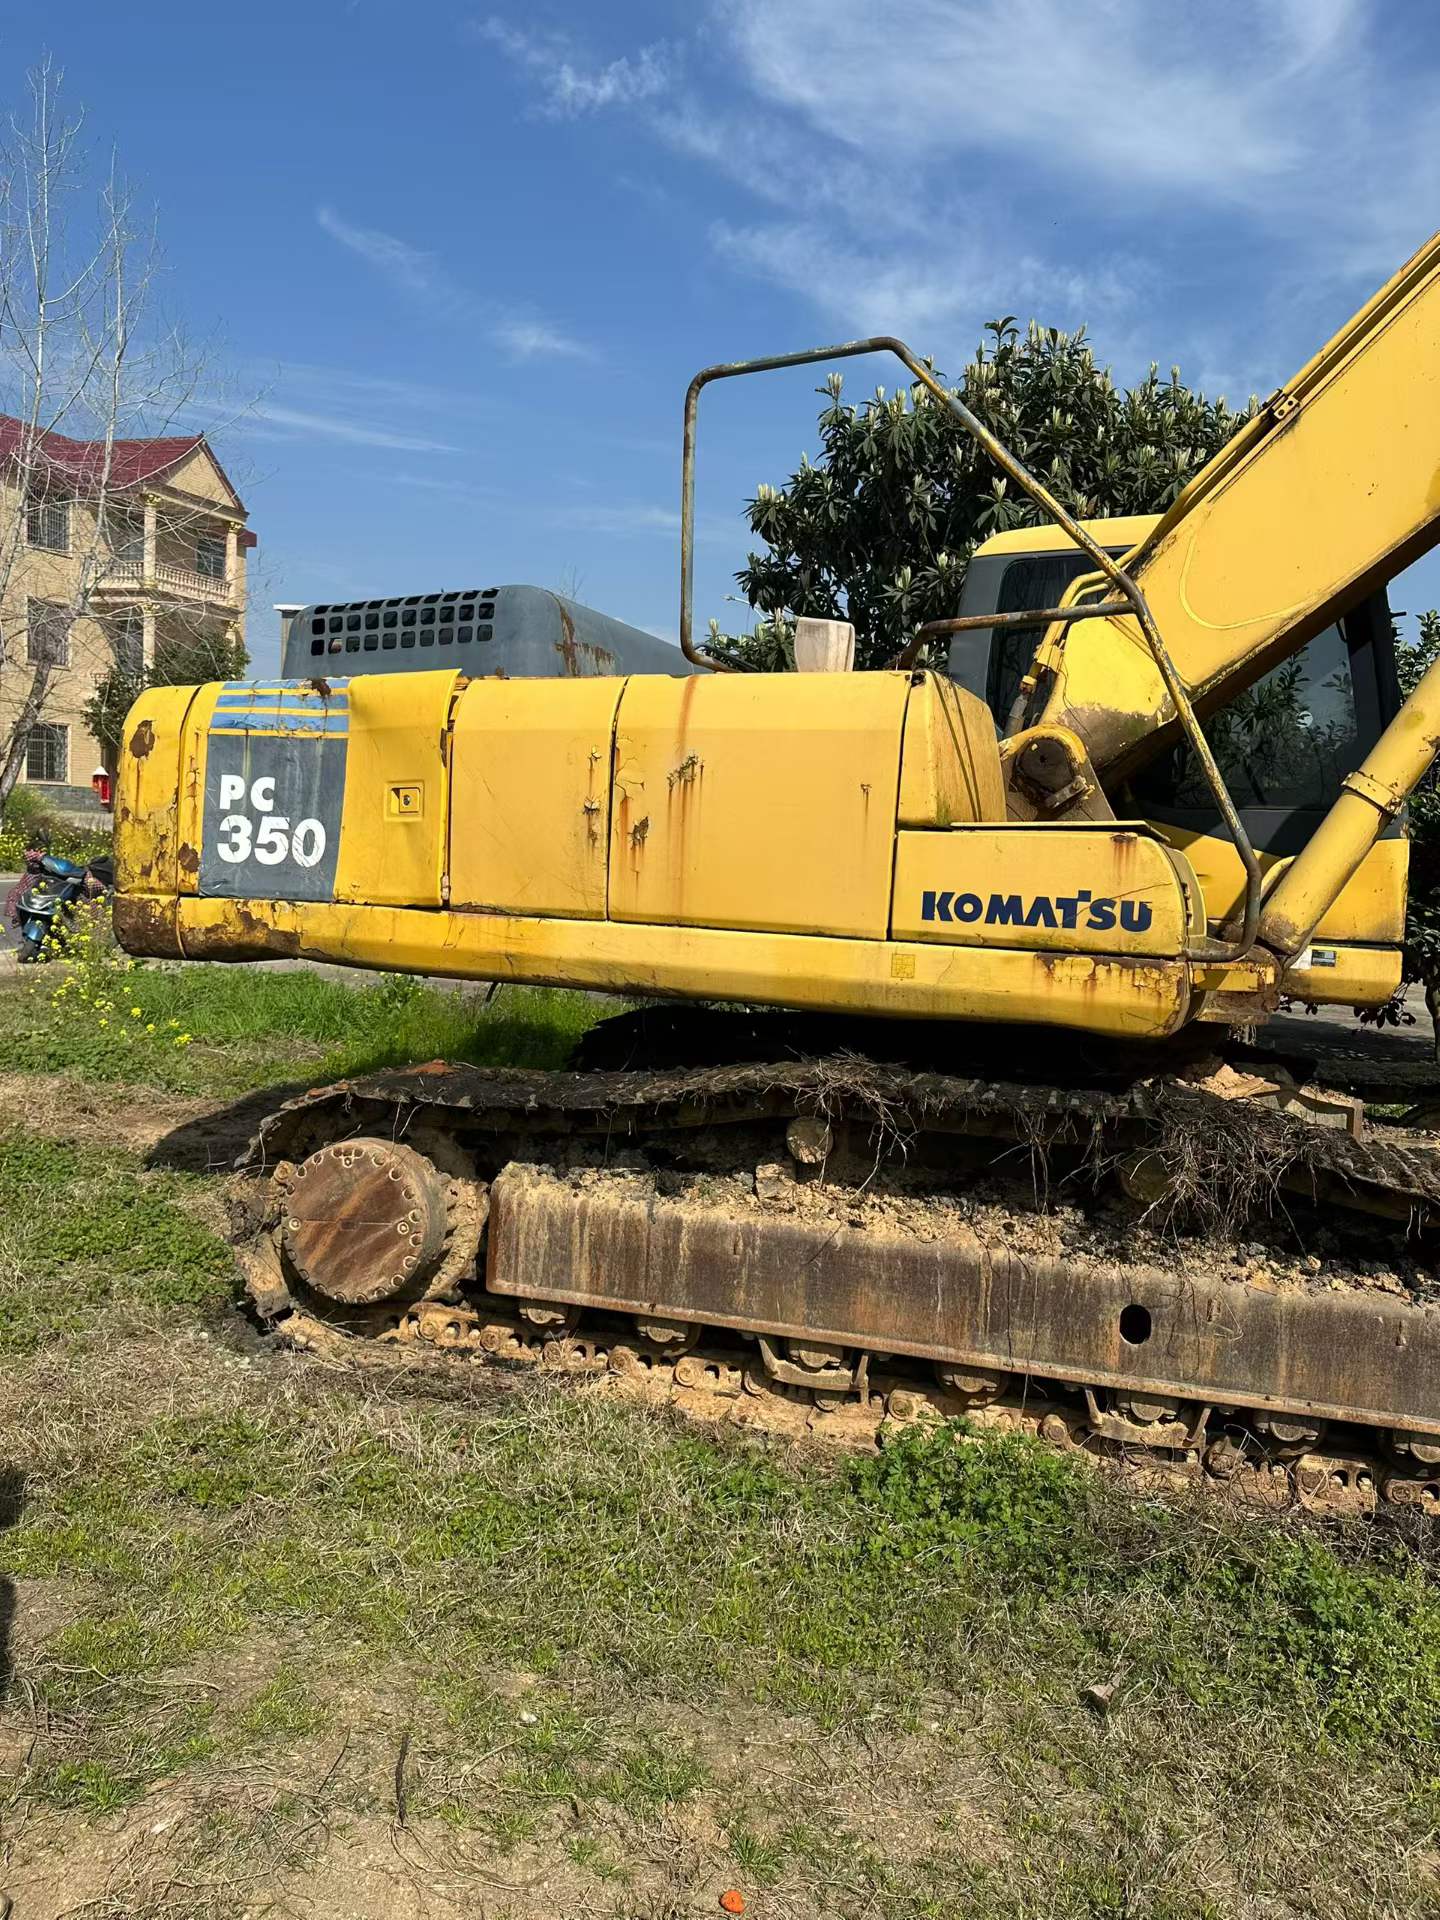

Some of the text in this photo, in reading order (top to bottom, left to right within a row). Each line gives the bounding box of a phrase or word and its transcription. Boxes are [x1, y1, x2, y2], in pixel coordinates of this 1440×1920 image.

[219, 774, 276, 812] PC
[216, 814, 327, 868] 350
[921, 890, 1153, 932] KOMATSU
